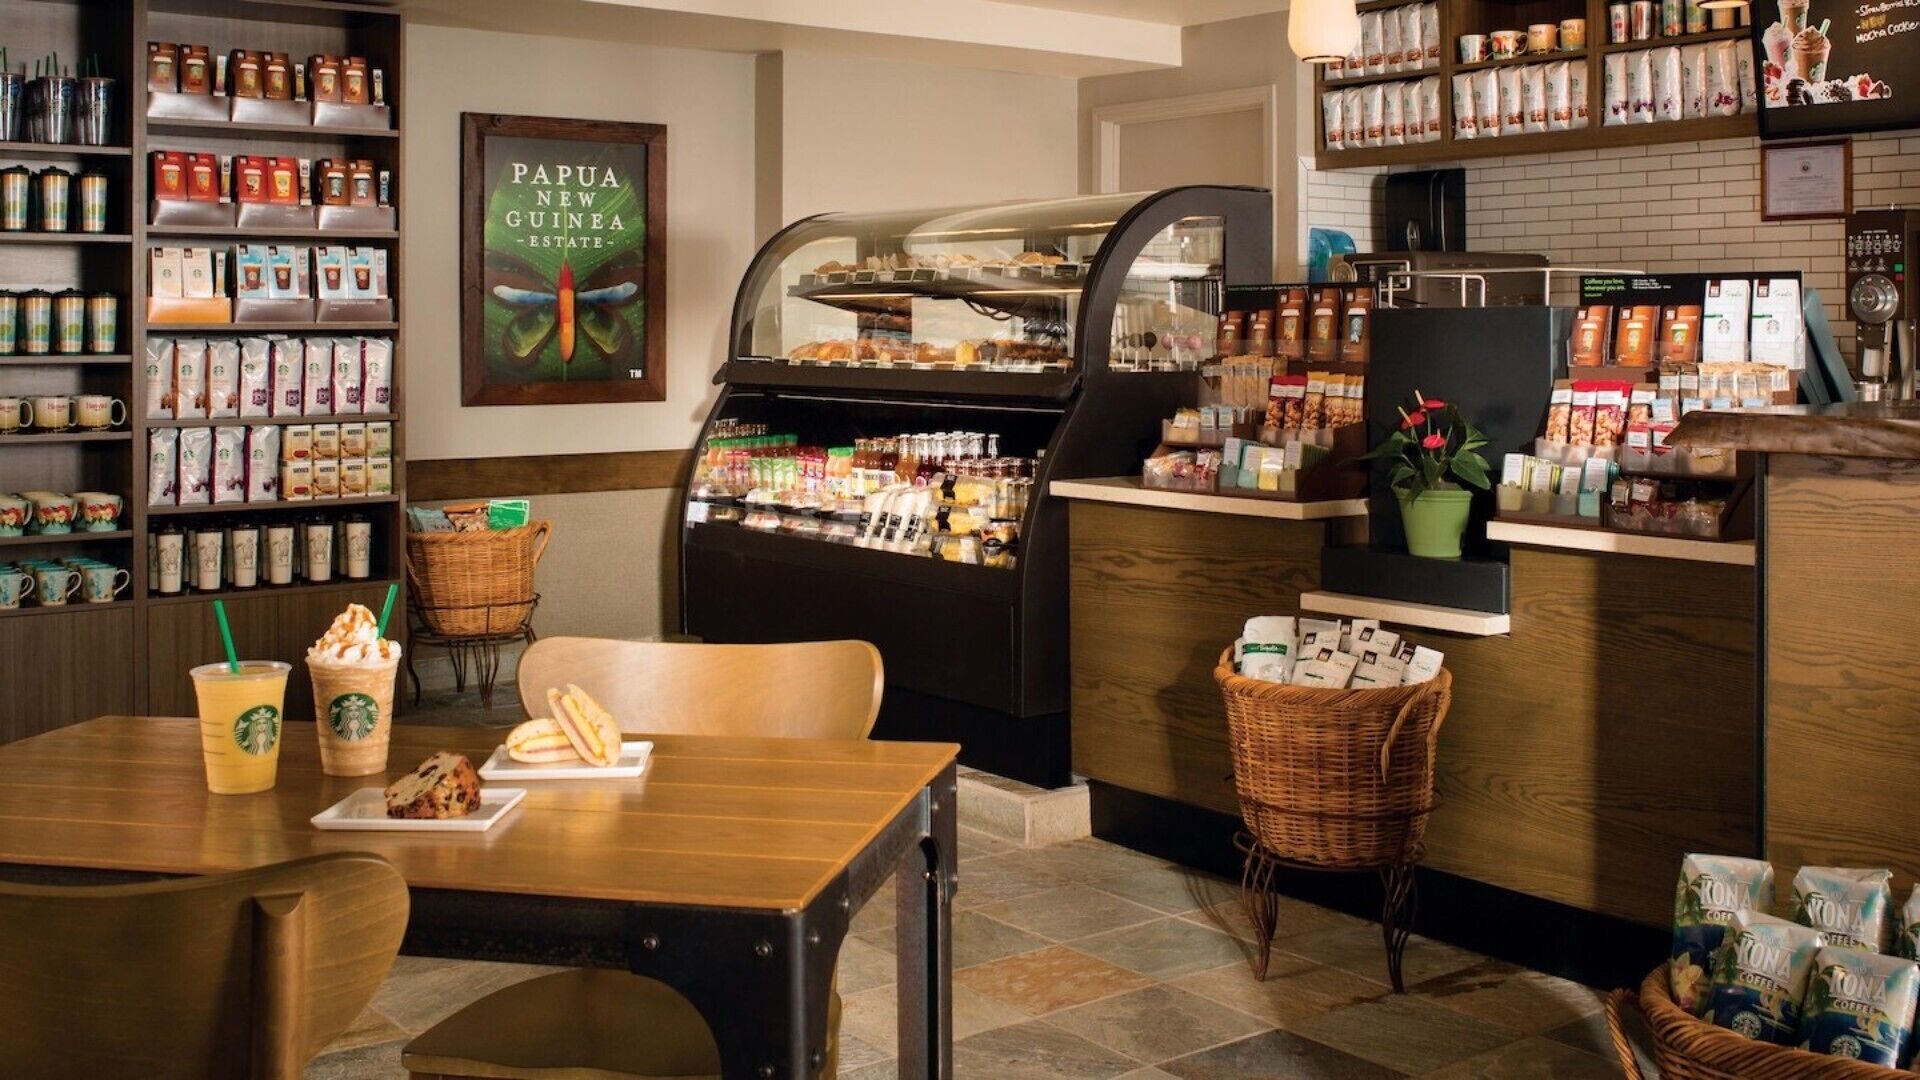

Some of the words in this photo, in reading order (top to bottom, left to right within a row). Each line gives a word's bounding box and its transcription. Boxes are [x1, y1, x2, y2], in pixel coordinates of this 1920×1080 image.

[512, 163, 620, 188] PAPUA
[537, 190, 597, 207] NEW
[506, 210, 624, 230] GUINEA
[1700, 879, 1753, 911] KONA
[1810, 897, 1865, 935] KONA
[1736, 937, 1792, 980] KONA
[1739, 972, 1779, 993] COFFEE
[1829, 966, 1888, 1008] KONA
[1833, 999, 1875, 1014] COFFEE
